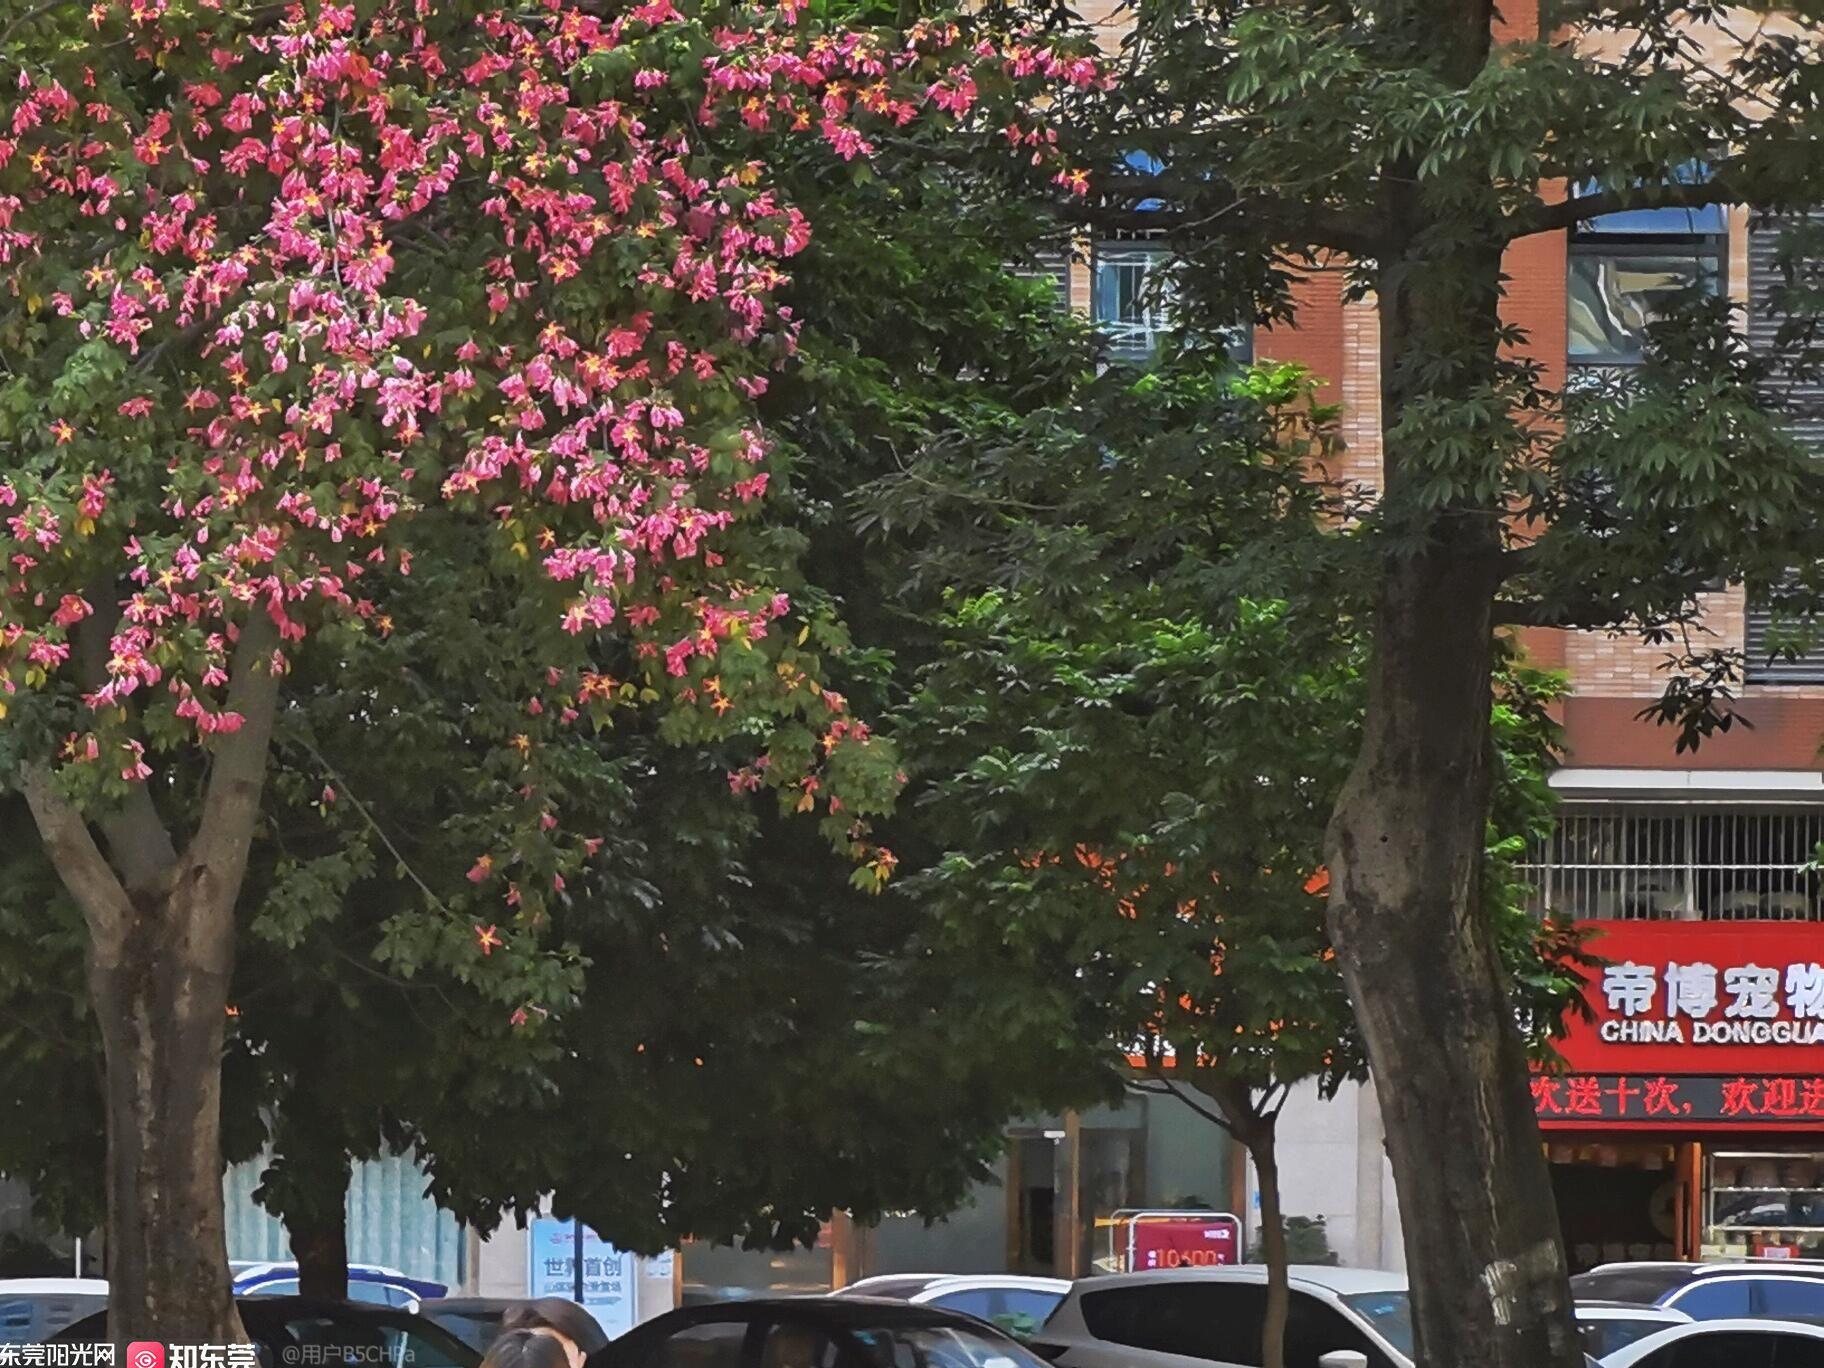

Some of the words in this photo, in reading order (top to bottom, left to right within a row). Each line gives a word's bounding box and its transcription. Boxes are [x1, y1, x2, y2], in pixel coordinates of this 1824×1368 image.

[1601, 960, 1824, 1019] 帝博宠物
[1600, 1020, 1685, 1044] CHINA
